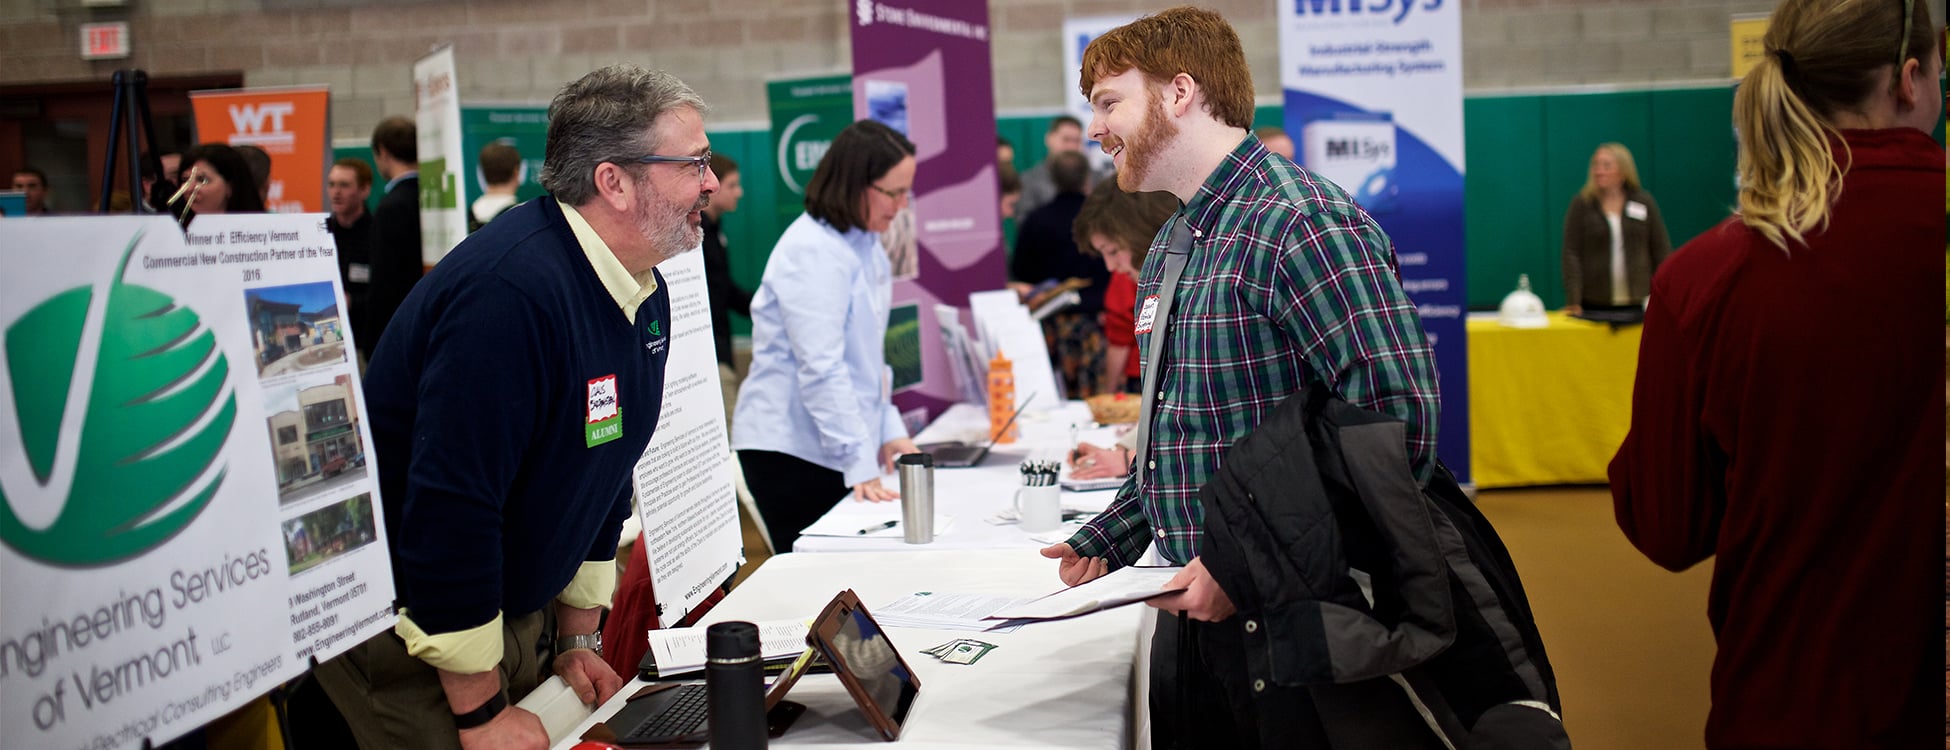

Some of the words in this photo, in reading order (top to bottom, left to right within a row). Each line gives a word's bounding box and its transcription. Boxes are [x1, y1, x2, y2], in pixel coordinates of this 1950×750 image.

[88, 27, 119, 55] EXIT
[228, 102, 296, 134] WT
[185, 232, 213, 247] Winner
[230, 230, 268, 246] Efficiency
[269, 230, 299, 243] Vermont
[143, 254, 198, 270] Commercial
[200, 252, 217, 266] New
[219, 250, 269, 265] Construction
[270, 249, 296, 263] Partner
[318, 246, 334, 257] Year
[242, 269, 262, 282] 2016
[591, 424, 618, 440] ALUMNI
[295, 582, 335, 606] Washington
[336, 572, 355, 587] Street
[0, 588, 165, 677] ngineering
[171, 548, 272, 609] Services
[290, 606, 320, 626] Rutland,
[321, 592, 350, 611] Vermont
[296, 606, 394, 660] www.EngineeringVermont.com
[33, 678, 67, 731] of
[211, 632, 232, 656] LLC
[162, 681, 233, 725] Consulting
[233, 654, 282, 693] Engineers
